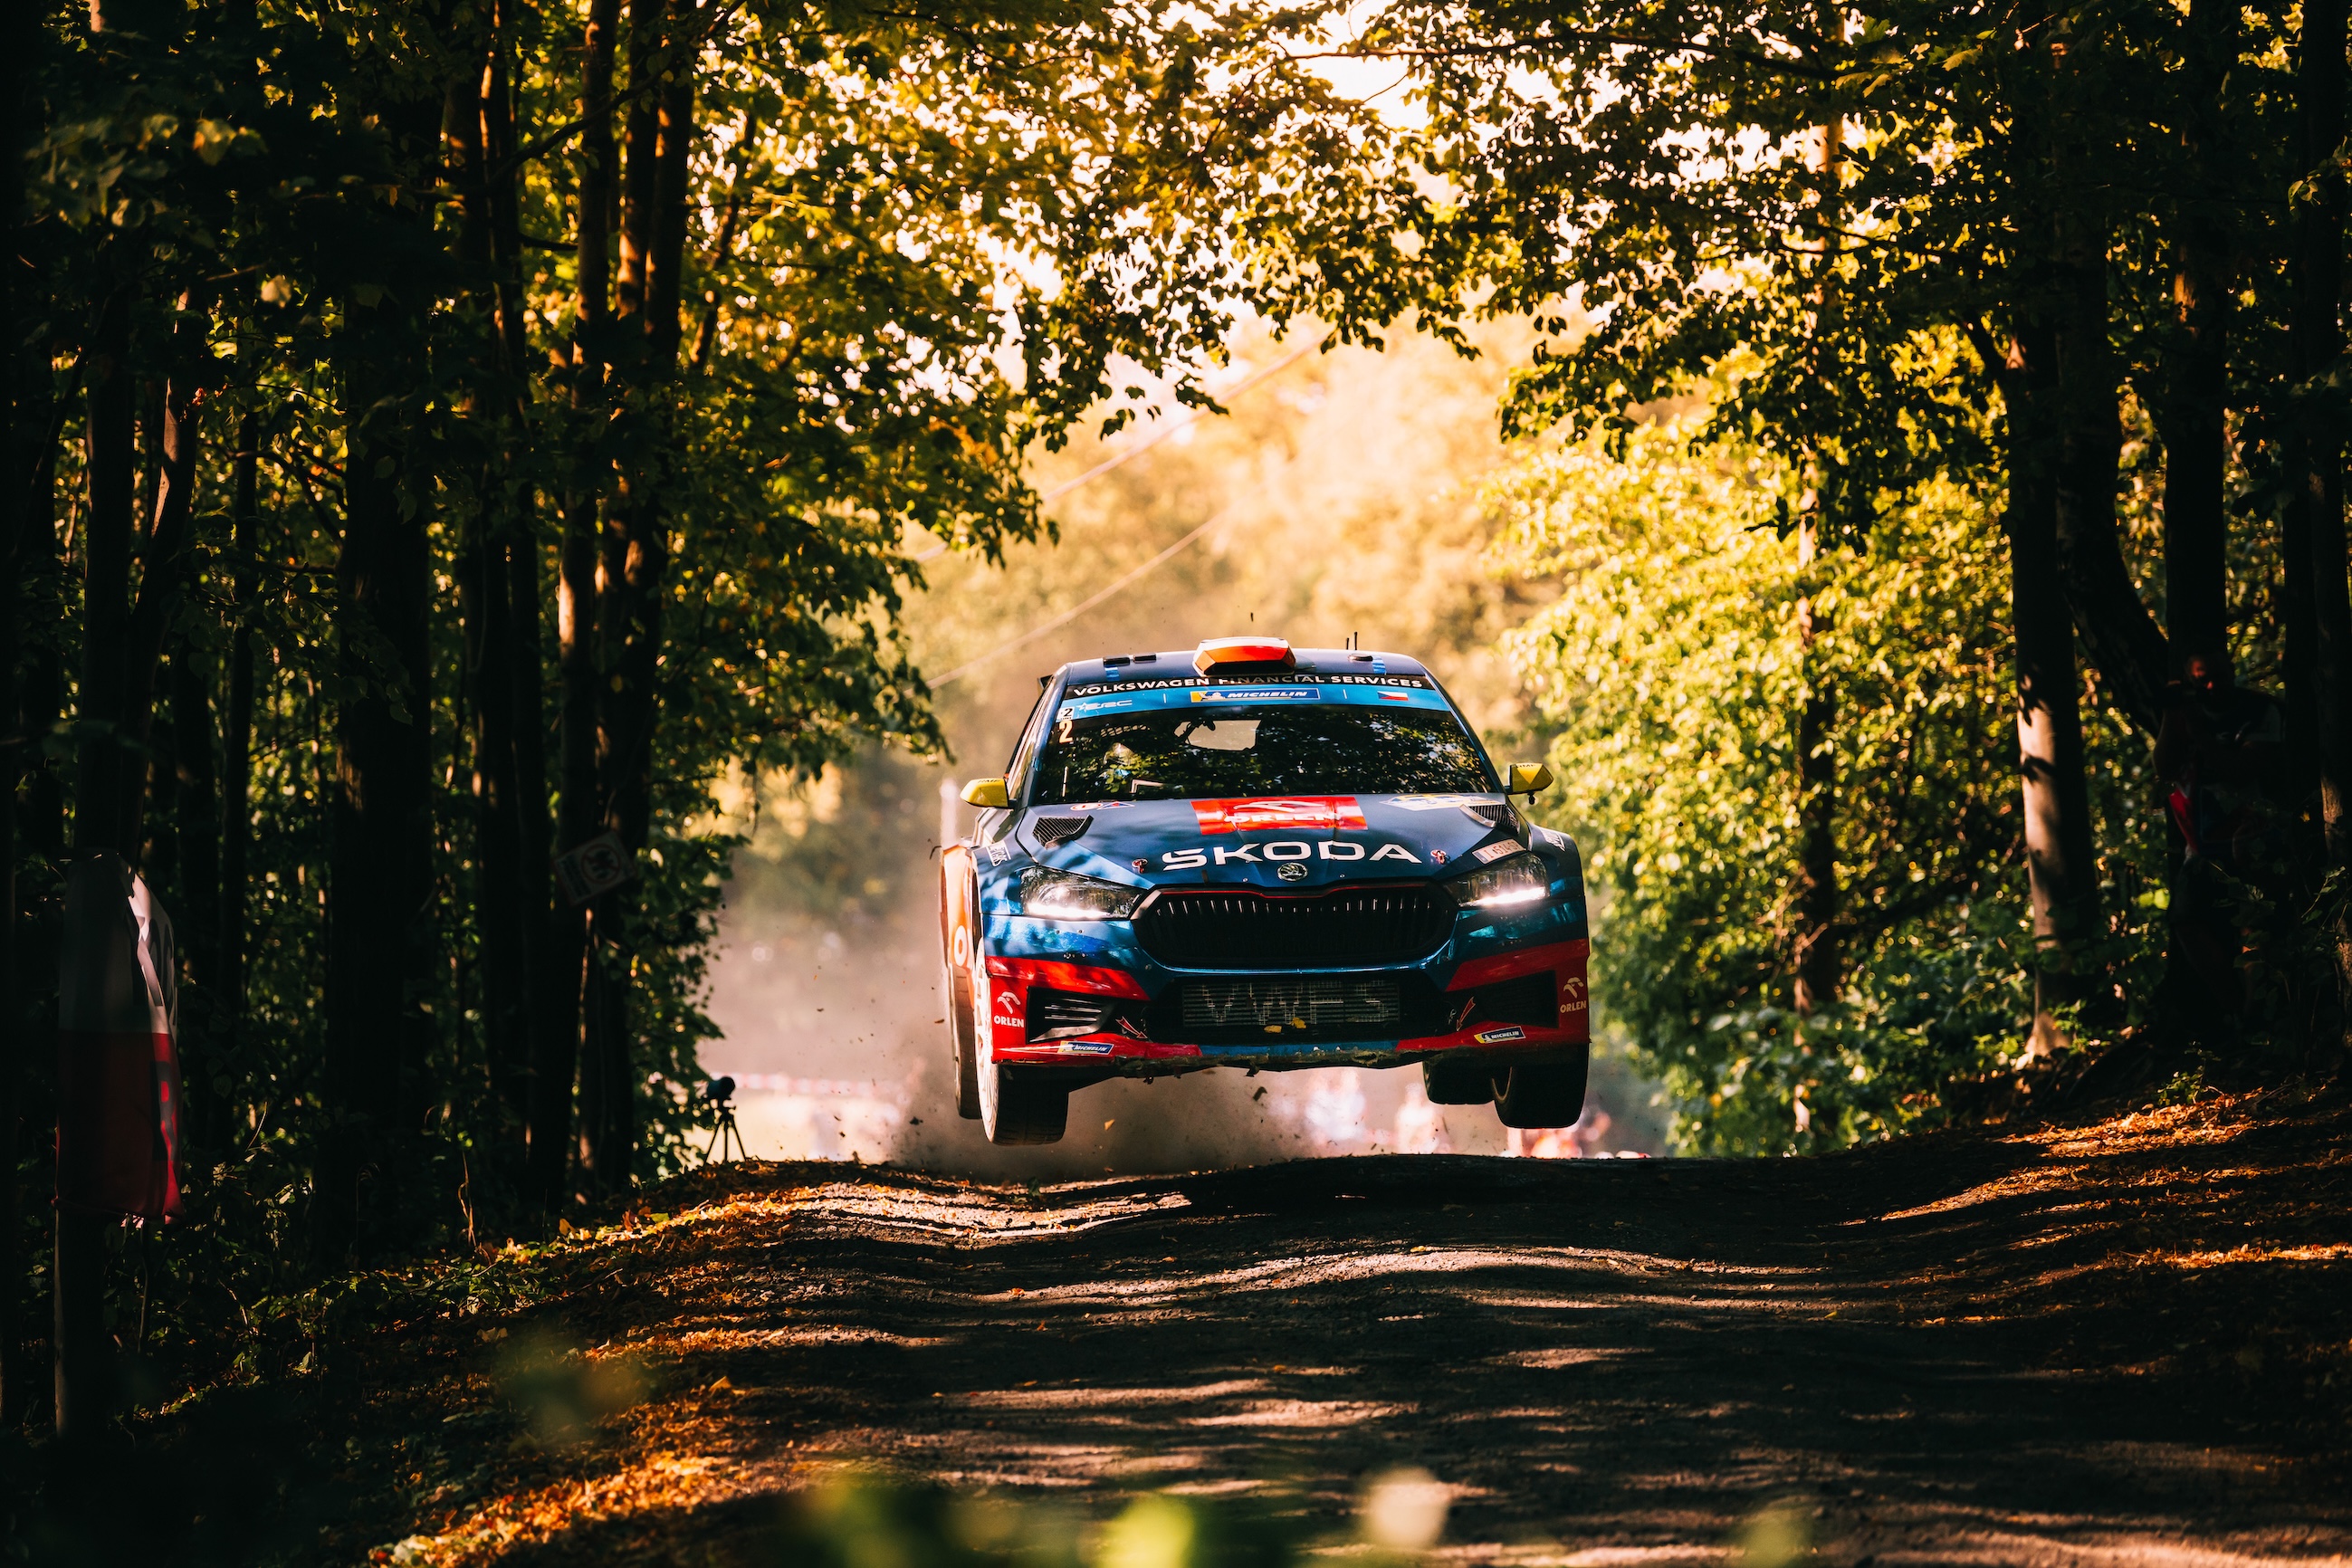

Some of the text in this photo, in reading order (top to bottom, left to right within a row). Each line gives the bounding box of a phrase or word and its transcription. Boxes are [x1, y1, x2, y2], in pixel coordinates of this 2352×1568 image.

[1073, 678, 1209, 696] VOLKSWAGEN
[1331, 675, 1422, 687] SERVICES
[1063, 708, 1073, 717] 2
[1059, 720, 1074, 743] 2
[1560, 1000, 1587, 1013] ORLEN
[993, 1015, 1025, 1028] ORLEN
[1491, 1031, 1519, 1039] MICHELIN
[1074, 1044, 1108, 1052] MICHELIN
